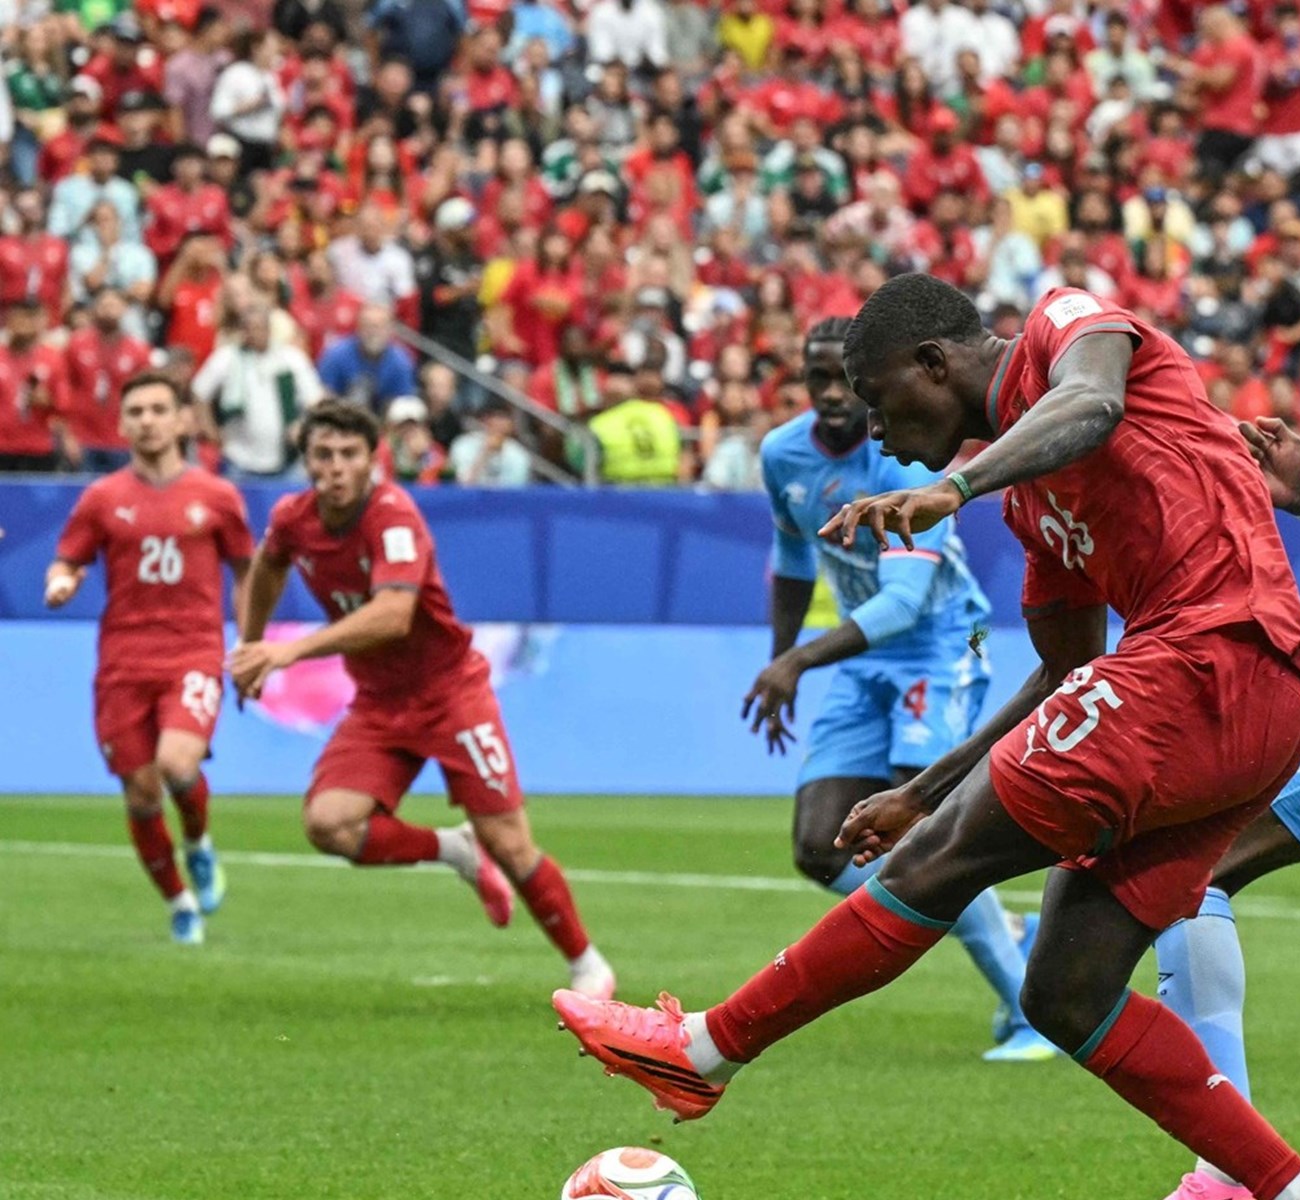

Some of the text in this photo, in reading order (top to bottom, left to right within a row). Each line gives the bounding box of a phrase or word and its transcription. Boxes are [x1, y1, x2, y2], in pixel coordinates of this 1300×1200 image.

[138, 535, 184, 585] 26
[903, 679, 928, 721] 4
[456, 722, 509, 779] 15
